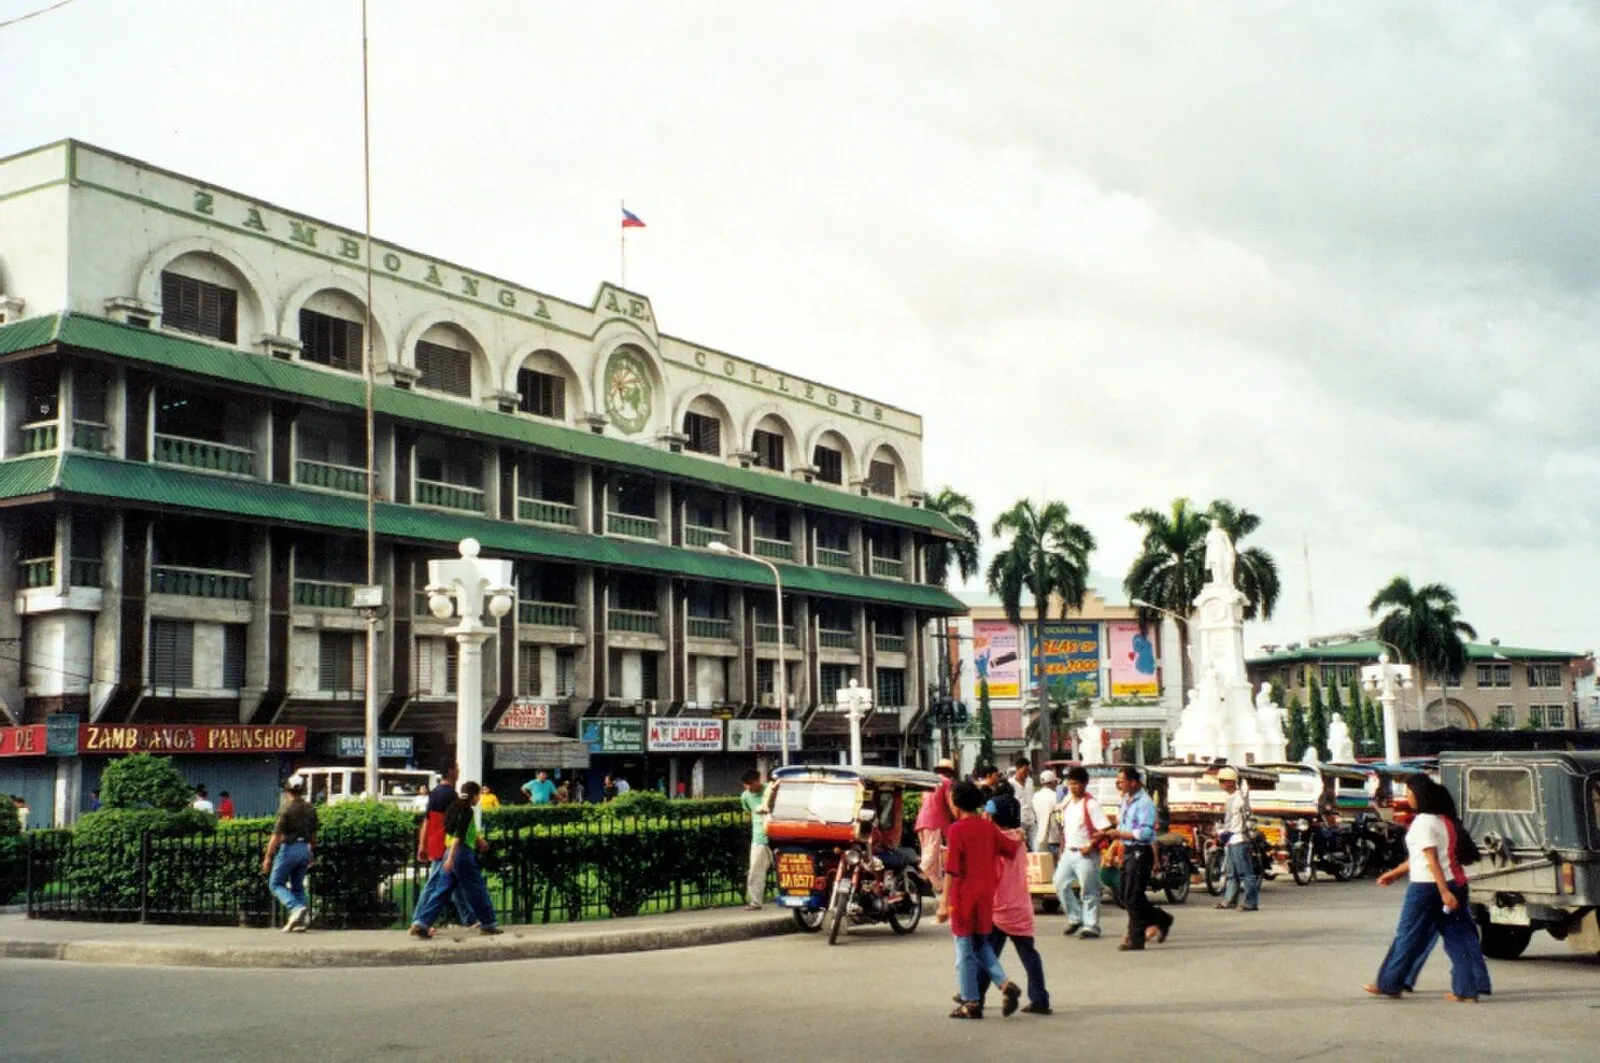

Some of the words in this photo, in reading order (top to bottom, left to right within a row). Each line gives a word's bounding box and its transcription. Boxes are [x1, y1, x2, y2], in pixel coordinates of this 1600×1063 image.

[194, 191, 552, 320] ZAMBOANGA
[605, 292, 650, 323] A.E.
[694, 351, 883, 421] COLLEGES
[207, 728, 296, 749] PAWNSHOP
[671, 727, 721, 742] LHUILLIER
